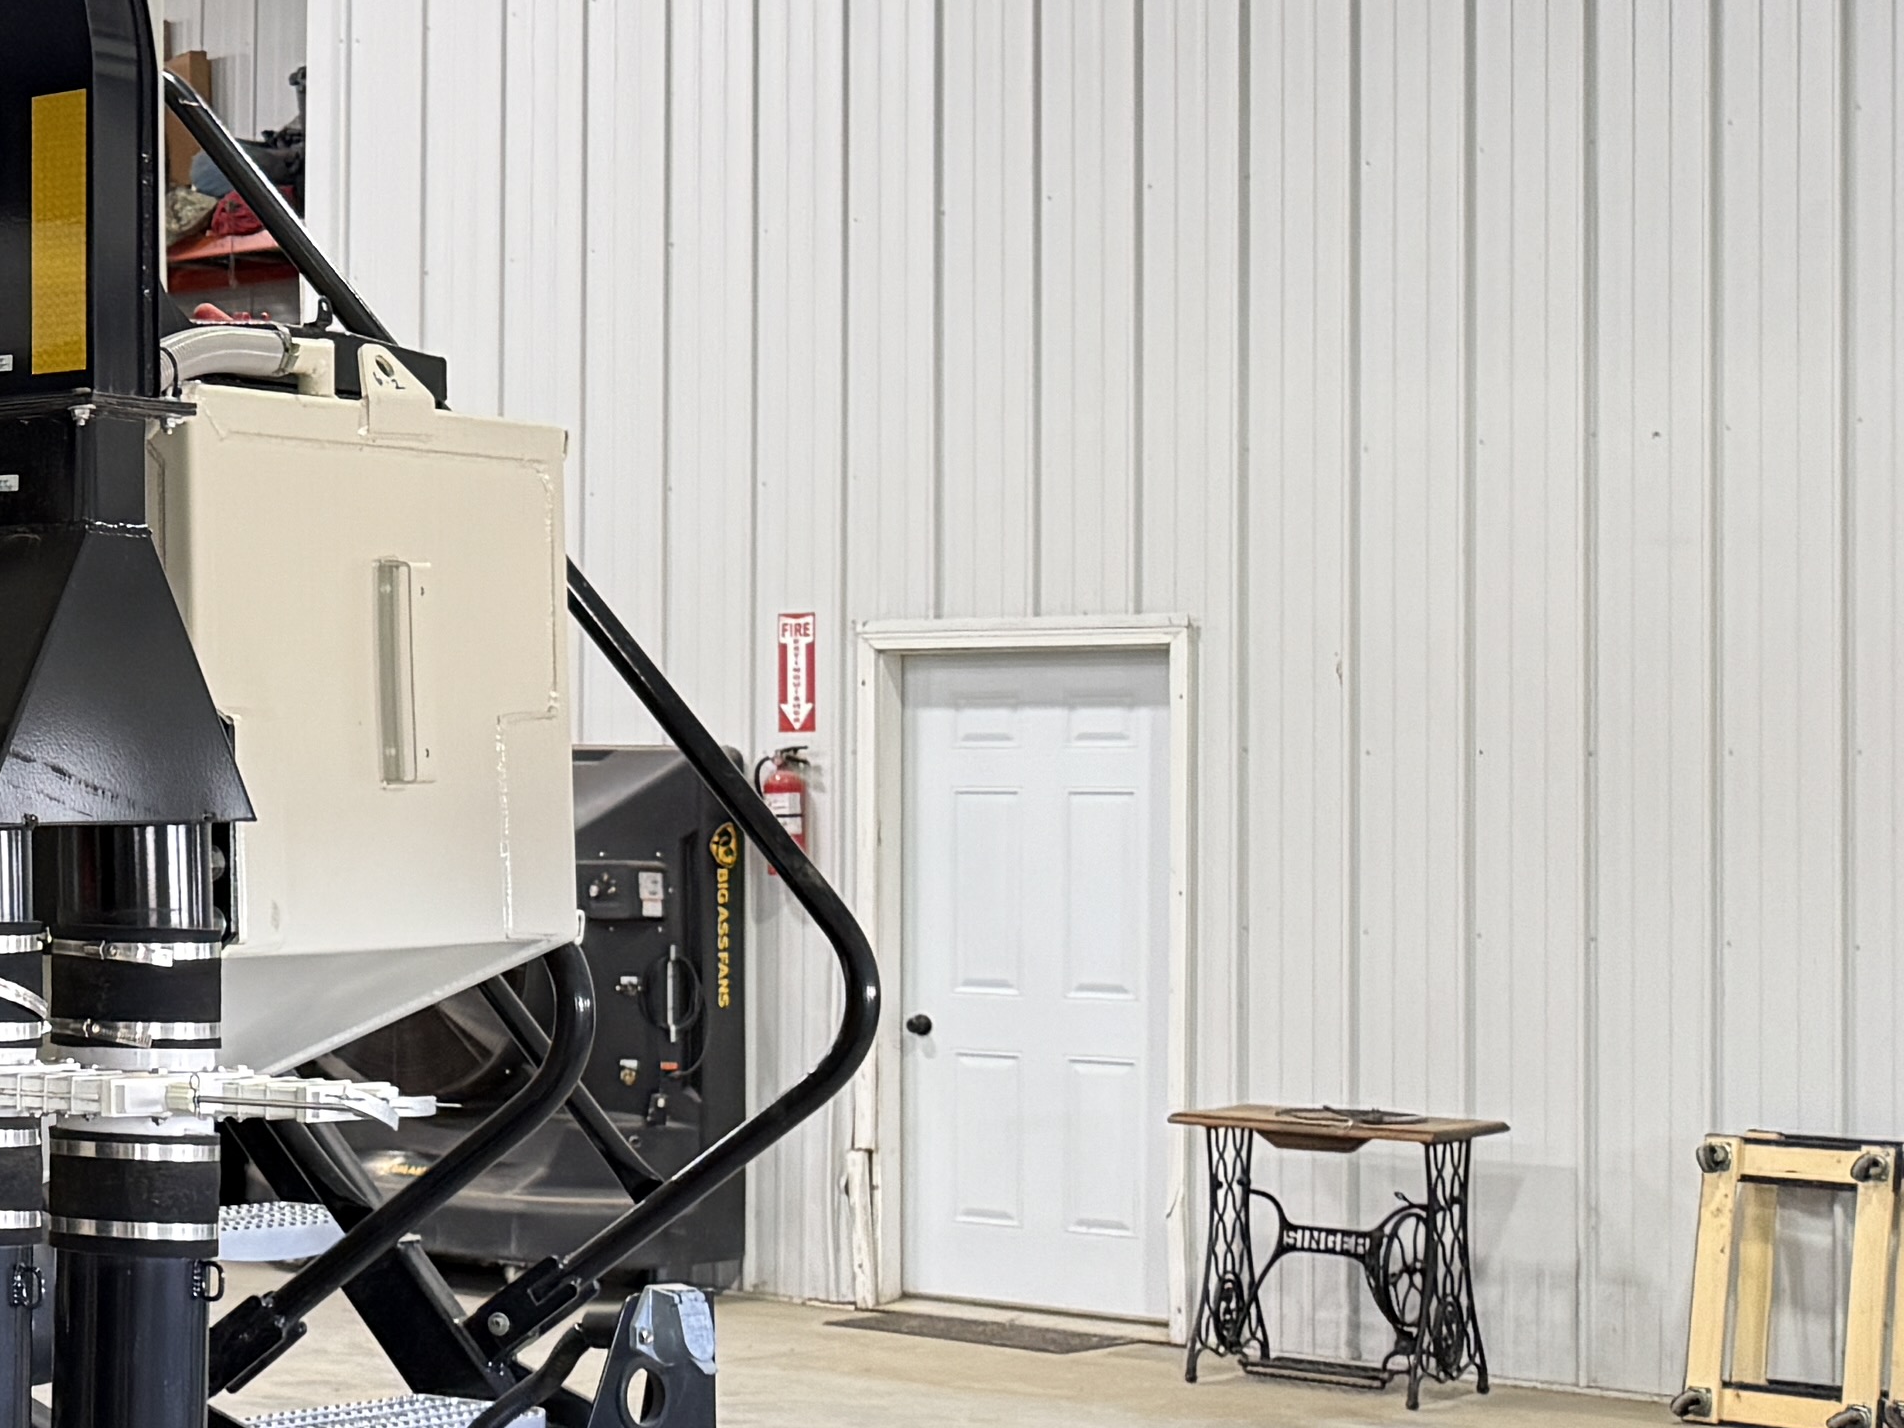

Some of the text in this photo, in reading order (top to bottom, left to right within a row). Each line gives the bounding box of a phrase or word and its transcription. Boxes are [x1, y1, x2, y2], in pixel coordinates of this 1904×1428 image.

[780, 621, 811, 638] FIRE
[716, 867, 731, 1009] BIG ASS FANS
[1283, 1228, 1371, 1255] SINGER
